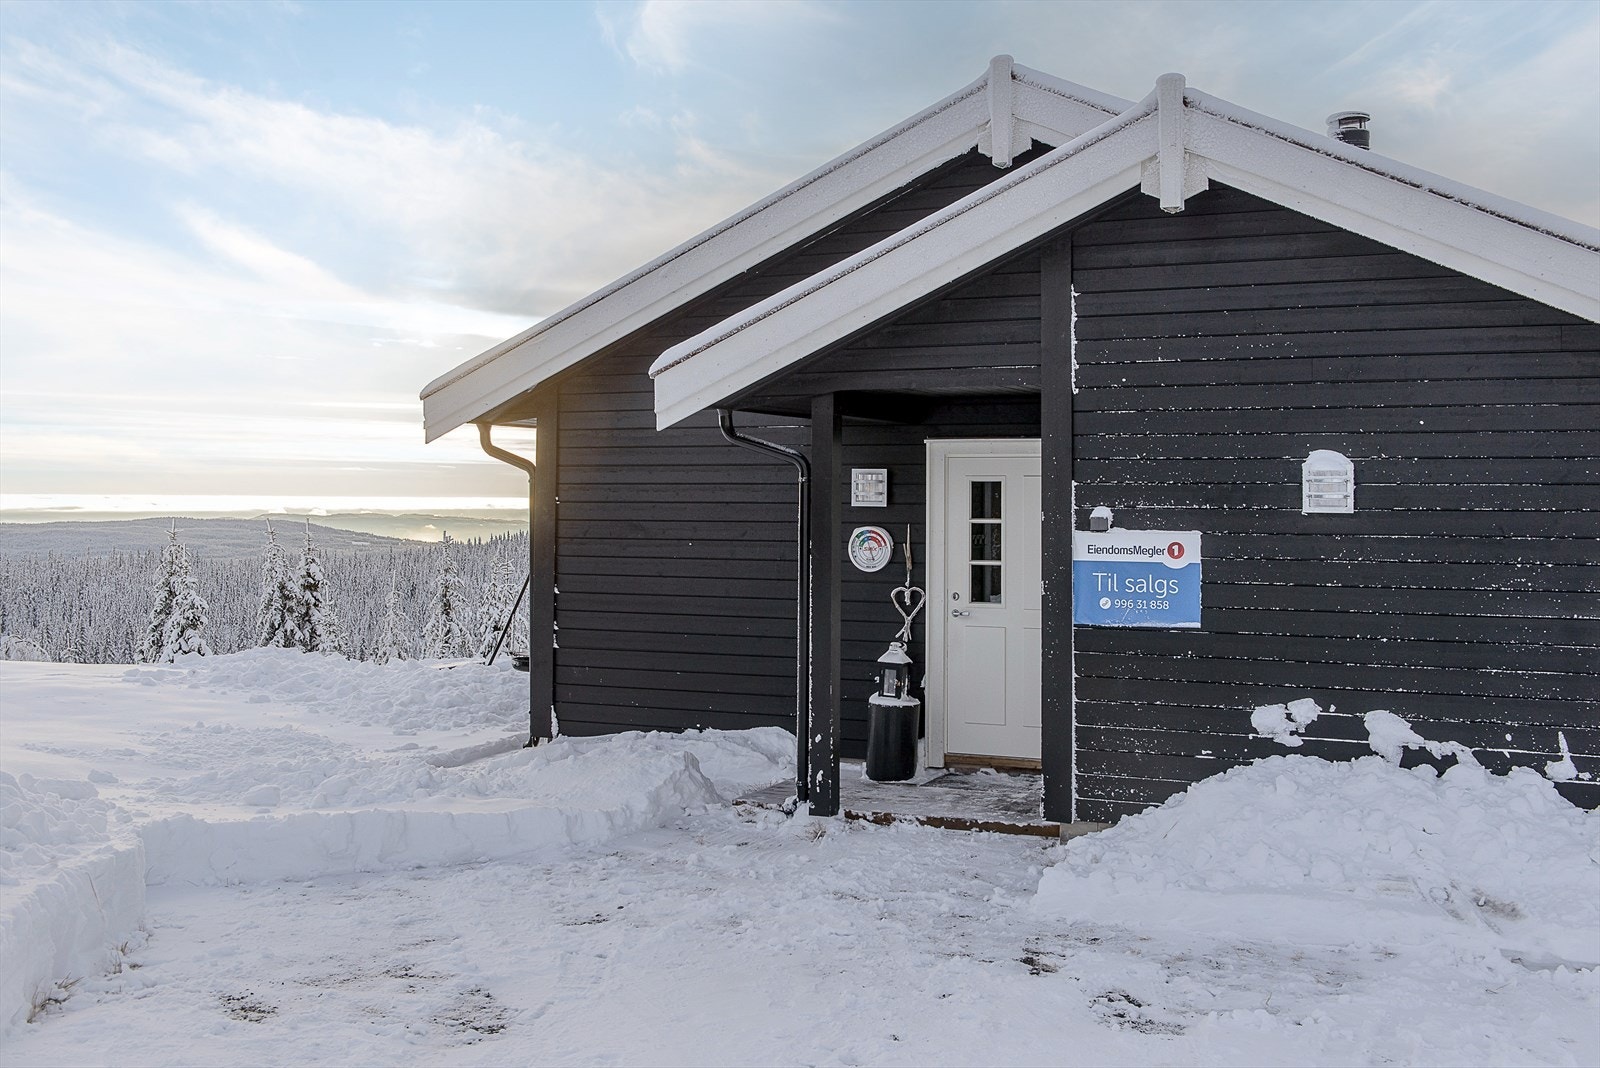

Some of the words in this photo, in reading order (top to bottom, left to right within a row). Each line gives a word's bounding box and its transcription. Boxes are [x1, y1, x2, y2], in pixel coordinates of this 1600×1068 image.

[1087, 545, 1166, 558] EiendomsMegler
[1092, 572, 1118, 592] Til
[1125, 574, 1179, 599] salgs
[1114, 599, 1134, 609] 996
[1136, 600, 1147, 609] 31
[1149, 600, 1170, 610] 858
